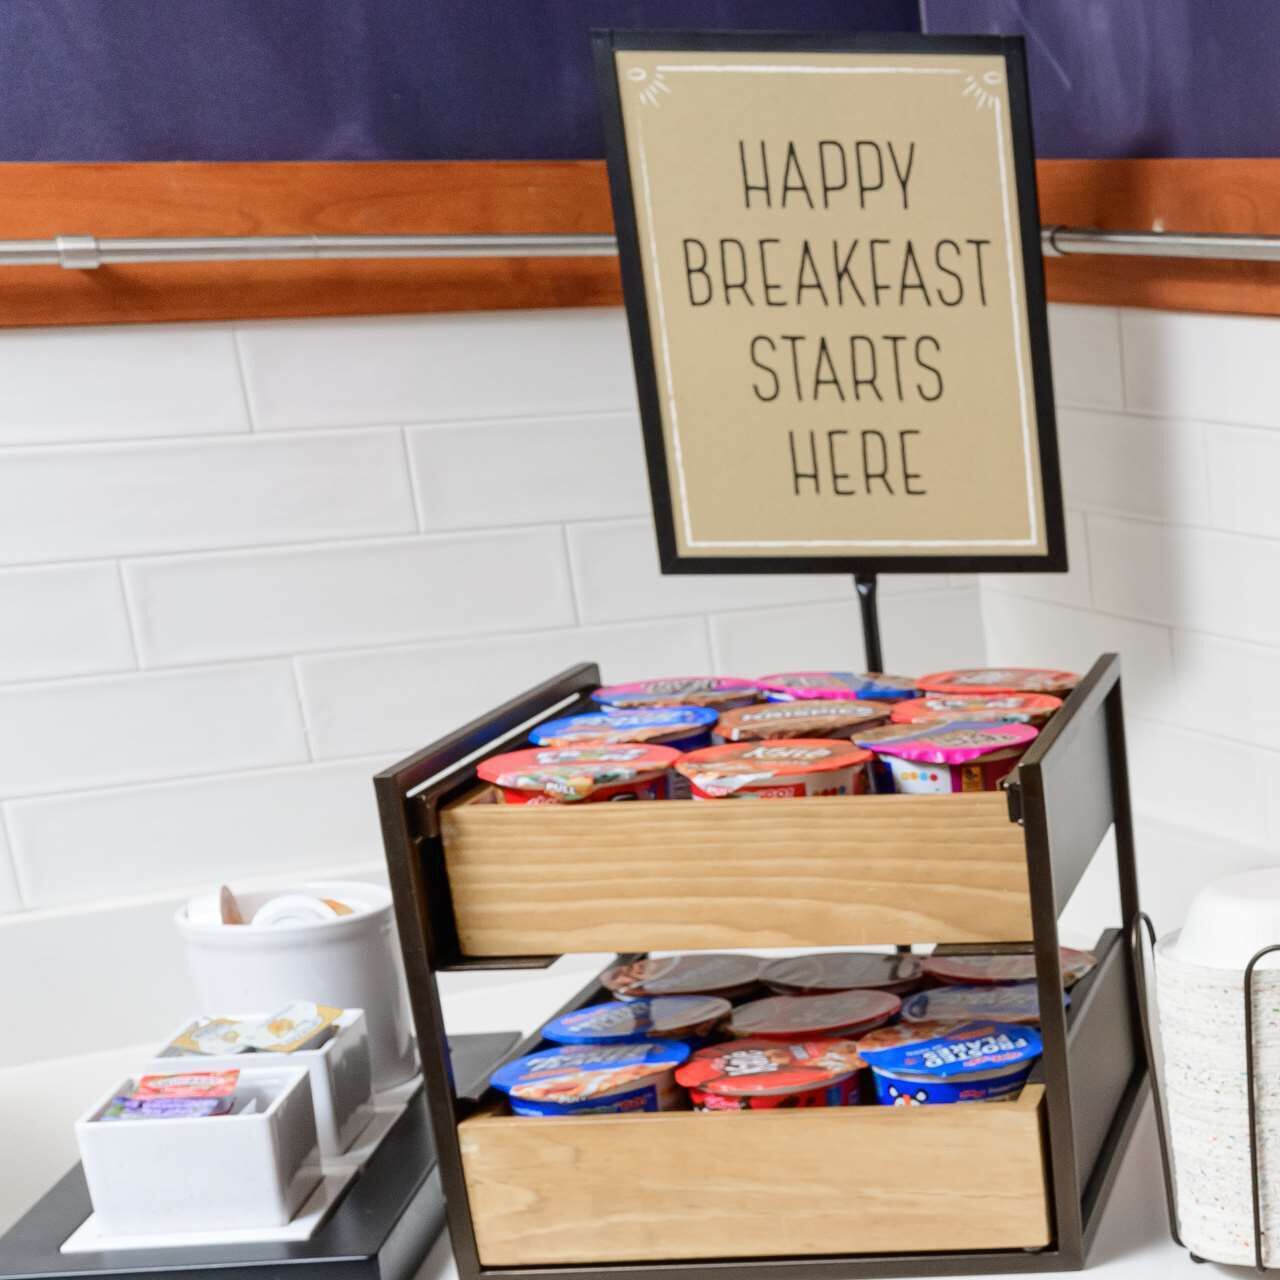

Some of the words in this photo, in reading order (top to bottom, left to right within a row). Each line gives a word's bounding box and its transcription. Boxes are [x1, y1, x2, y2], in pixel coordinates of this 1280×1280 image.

[738, 139, 916, 209] HAPPY
[682, 238, 991, 307] BREAKFAST
[749, 335, 944, 403] STARTS
[788, 429, 927, 497] HERE
